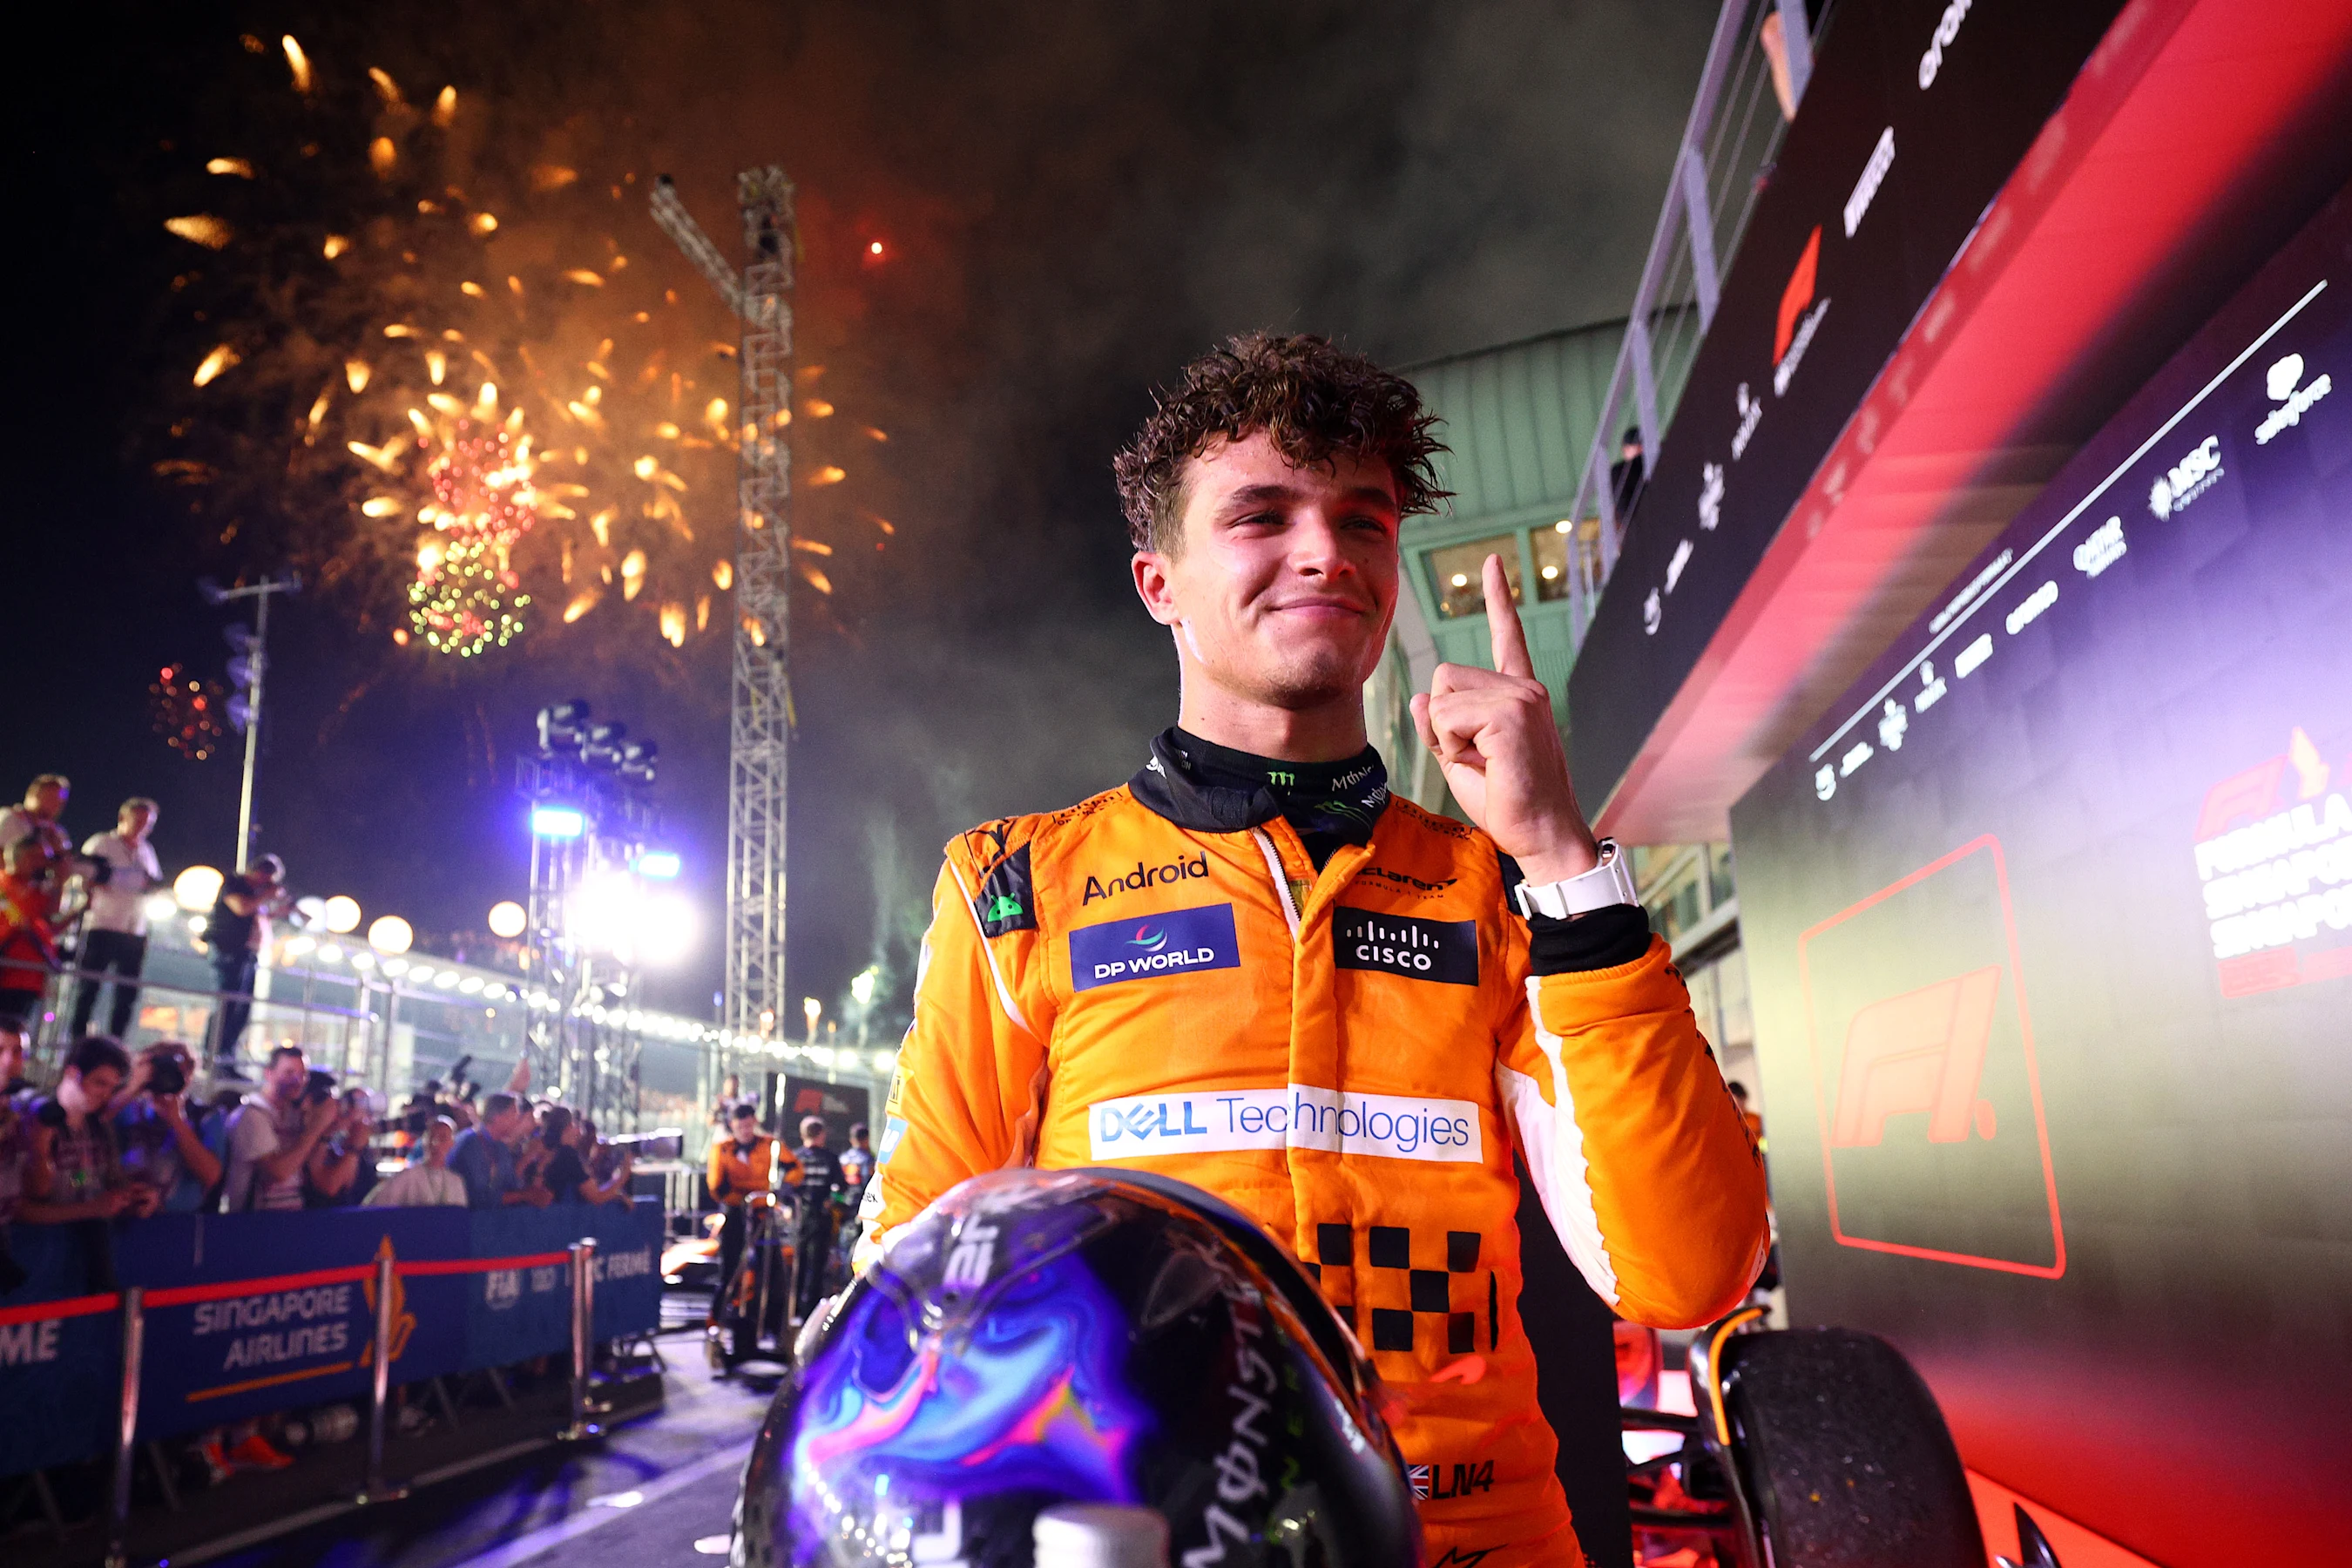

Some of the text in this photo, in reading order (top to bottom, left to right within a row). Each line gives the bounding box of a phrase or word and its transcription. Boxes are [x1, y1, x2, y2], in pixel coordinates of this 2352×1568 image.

[2167, 435, 2221, 498] MSC
[1083, 850, 1209, 906] Android
[1356, 867, 1446, 891] cLaren
[1093, 947, 1215, 979] DP WORLD
[1355, 944, 1432, 971] CISCO
[1099, 1092, 1470, 1152] DELL Technologies
[193, 1285, 353, 1336] SINGAPORE
[222, 1321, 349, 1372] AIRLINES
[1432, 1460, 1495, 1500] LN4
